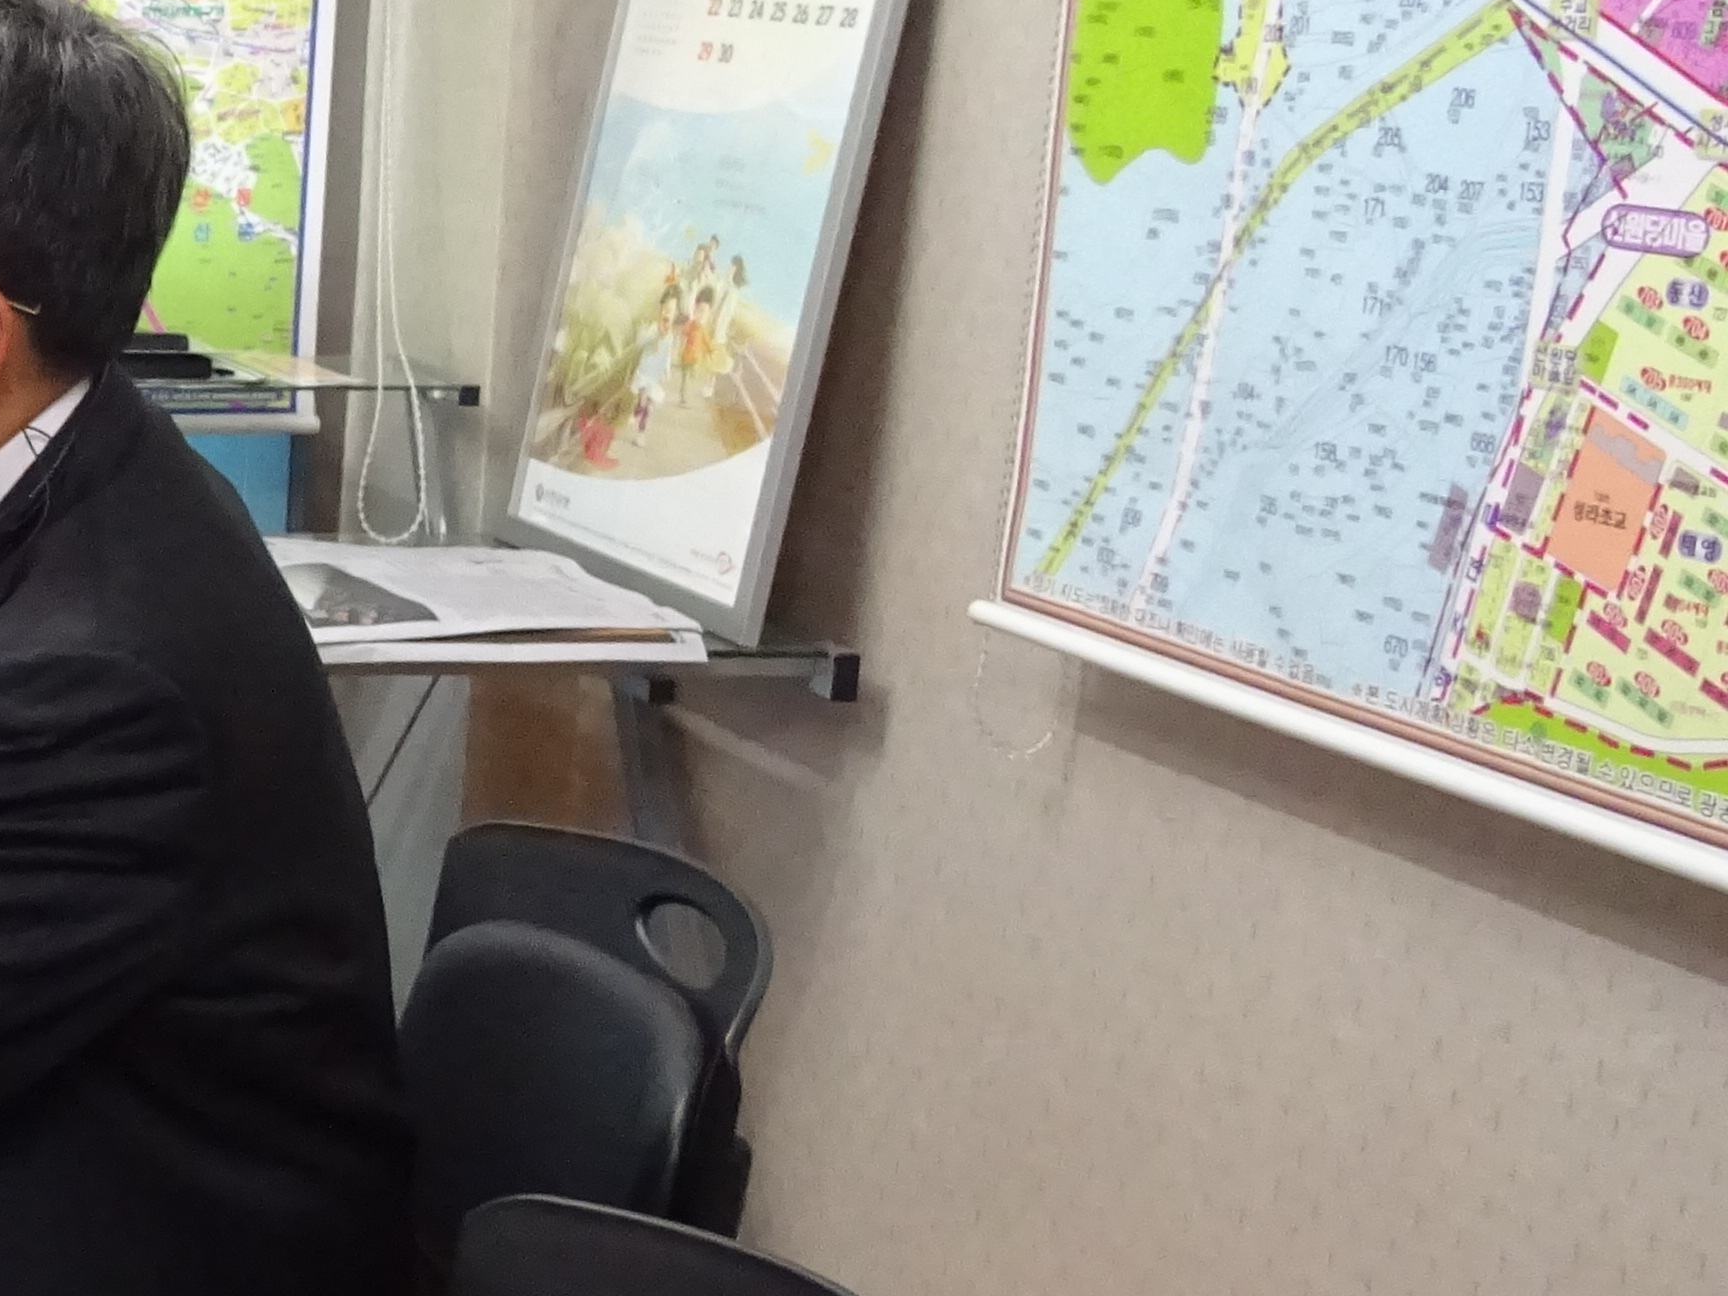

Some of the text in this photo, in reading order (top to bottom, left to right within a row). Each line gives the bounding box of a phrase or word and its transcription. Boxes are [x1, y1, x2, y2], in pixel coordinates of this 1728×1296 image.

[748, 0, 765, 19] 24
[770, 2, 786, 22] 25
[792, 4, 809, 24] 26
[815, 6, 834, 26] 27
[840, 8, 859, 28] 28
[698, 42, 733, 62] 29 30
[1452, 87, 1476, 108] 206
[1526, 121, 1551, 142] 153
[1425, 173, 1450, 194] 204
[1459, 180, 1485, 201] 207
[1519, 181, 1545, 203] 153
[1364, 197, 1386, 218] 171
[1362, 296, 1385, 317] 171
[1385, 345, 1409, 366] 170
[1413, 352, 1437, 373] 156
[1541, 741, 1593, 776] 변경될
[1597, 759, 1614, 779] 수
[1619, 765, 1693, 805] 있으므로
